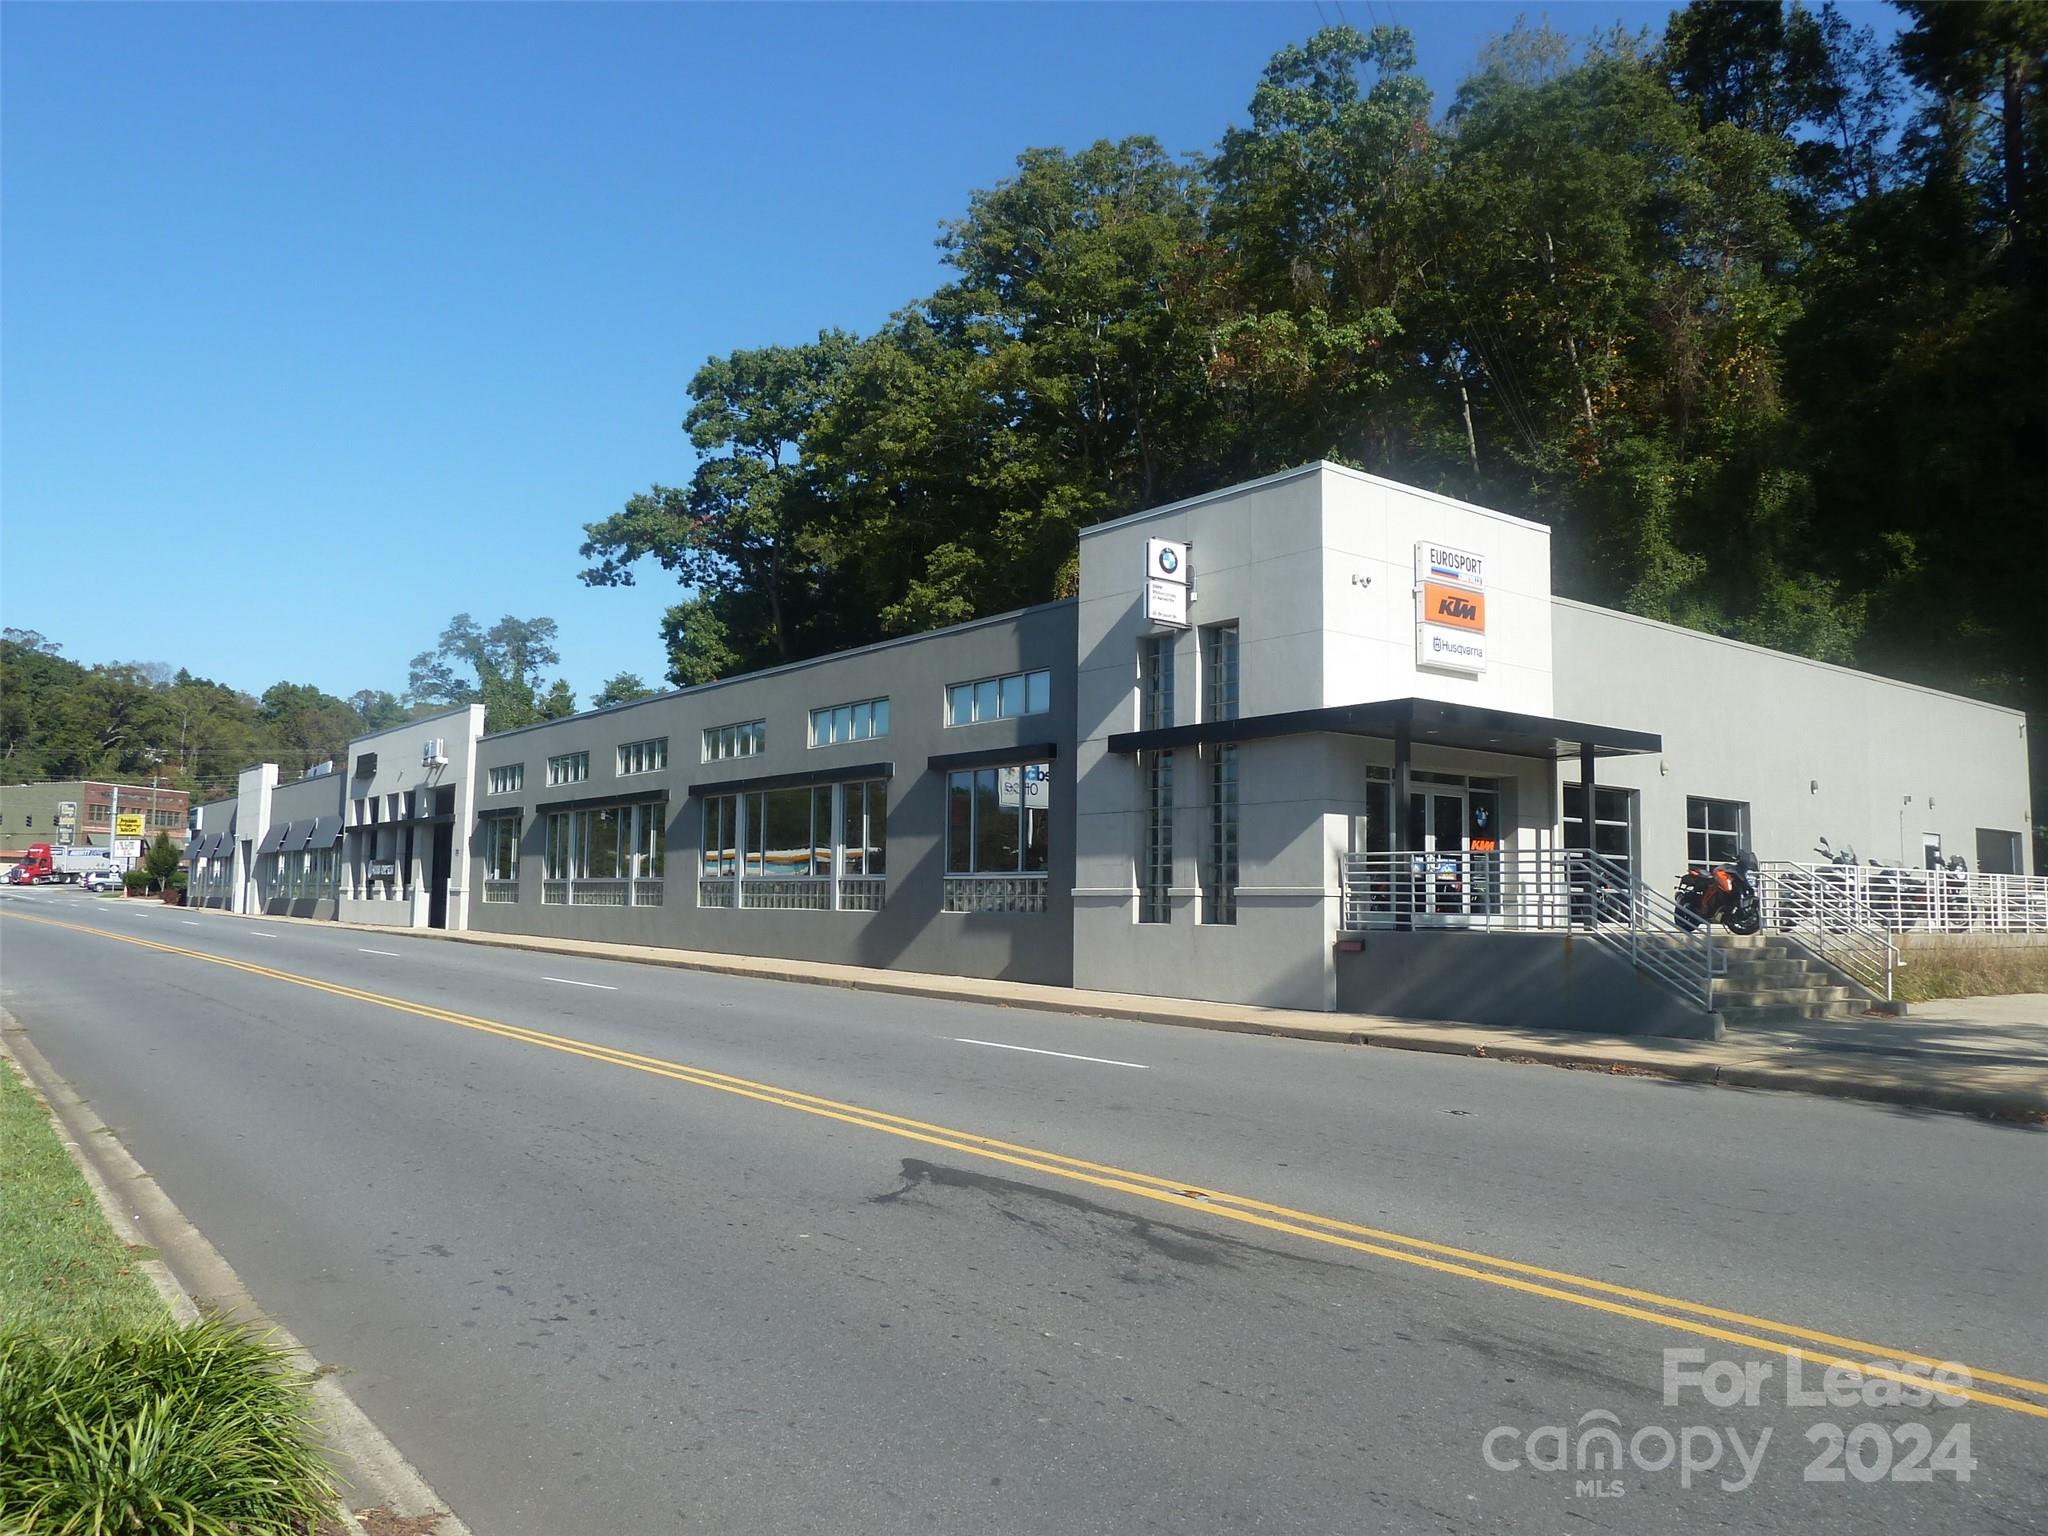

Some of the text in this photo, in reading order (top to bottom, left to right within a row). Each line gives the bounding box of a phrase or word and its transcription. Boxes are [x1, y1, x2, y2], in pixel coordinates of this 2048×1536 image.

[1430, 548, 1483, 575] EUROSPORT
[1438, 595, 1477, 621] KTM
[1441, 639, 1483, 658] Husqvarna
